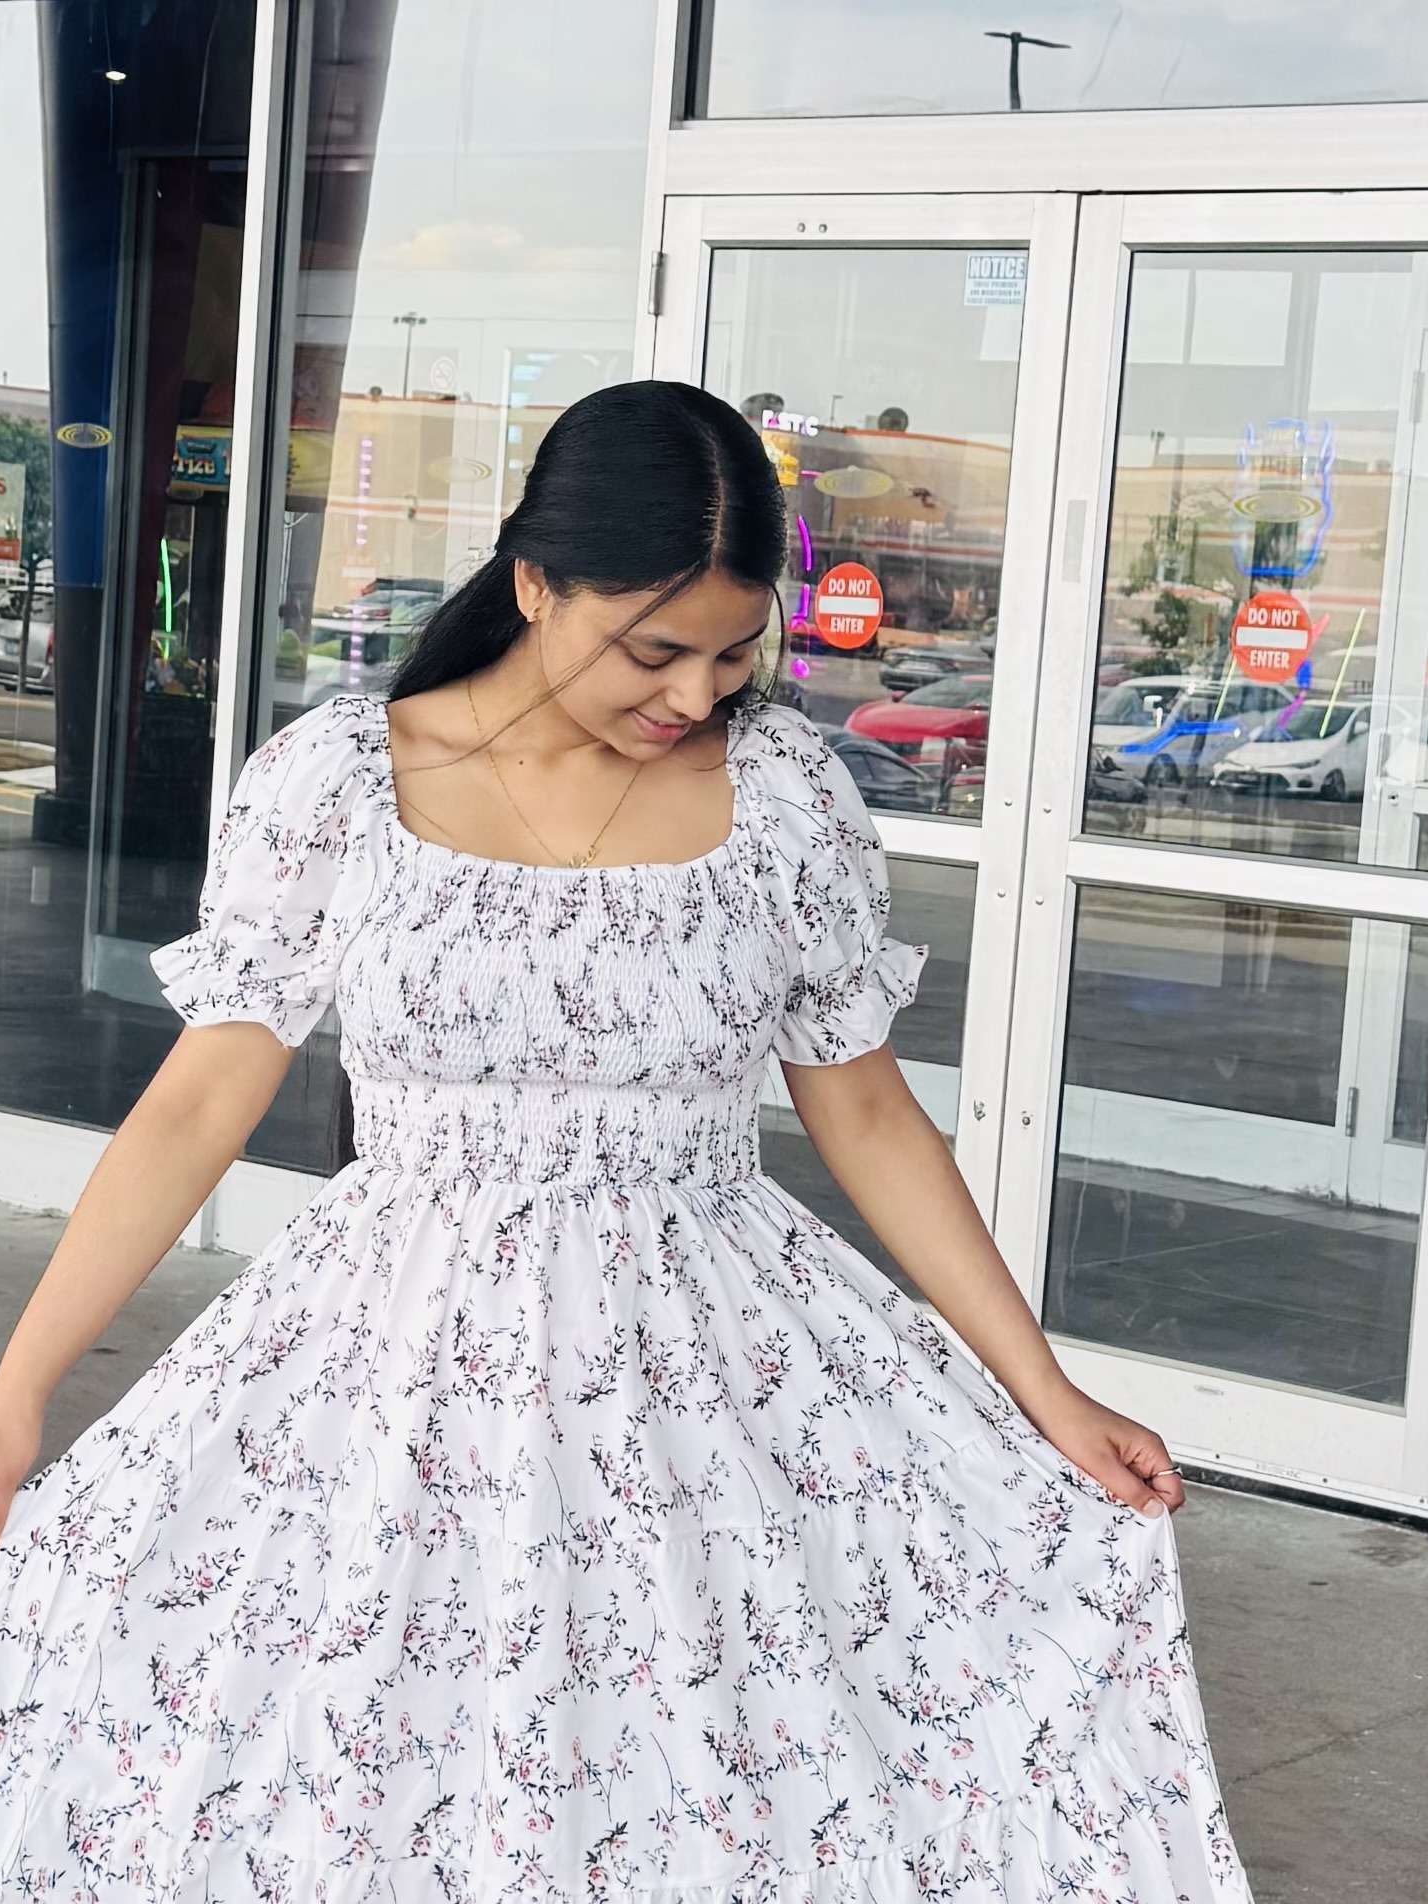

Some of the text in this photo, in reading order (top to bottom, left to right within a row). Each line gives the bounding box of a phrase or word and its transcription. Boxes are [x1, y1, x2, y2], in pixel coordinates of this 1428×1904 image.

[970, 256, 1025, 277] NOTICE
[828, 578, 872, 595] DO NOT
[830, 616, 865, 635] ENTER
[1248, 607, 1300, 627] DO NOT
[1249, 649, 1290, 670] ENTER
